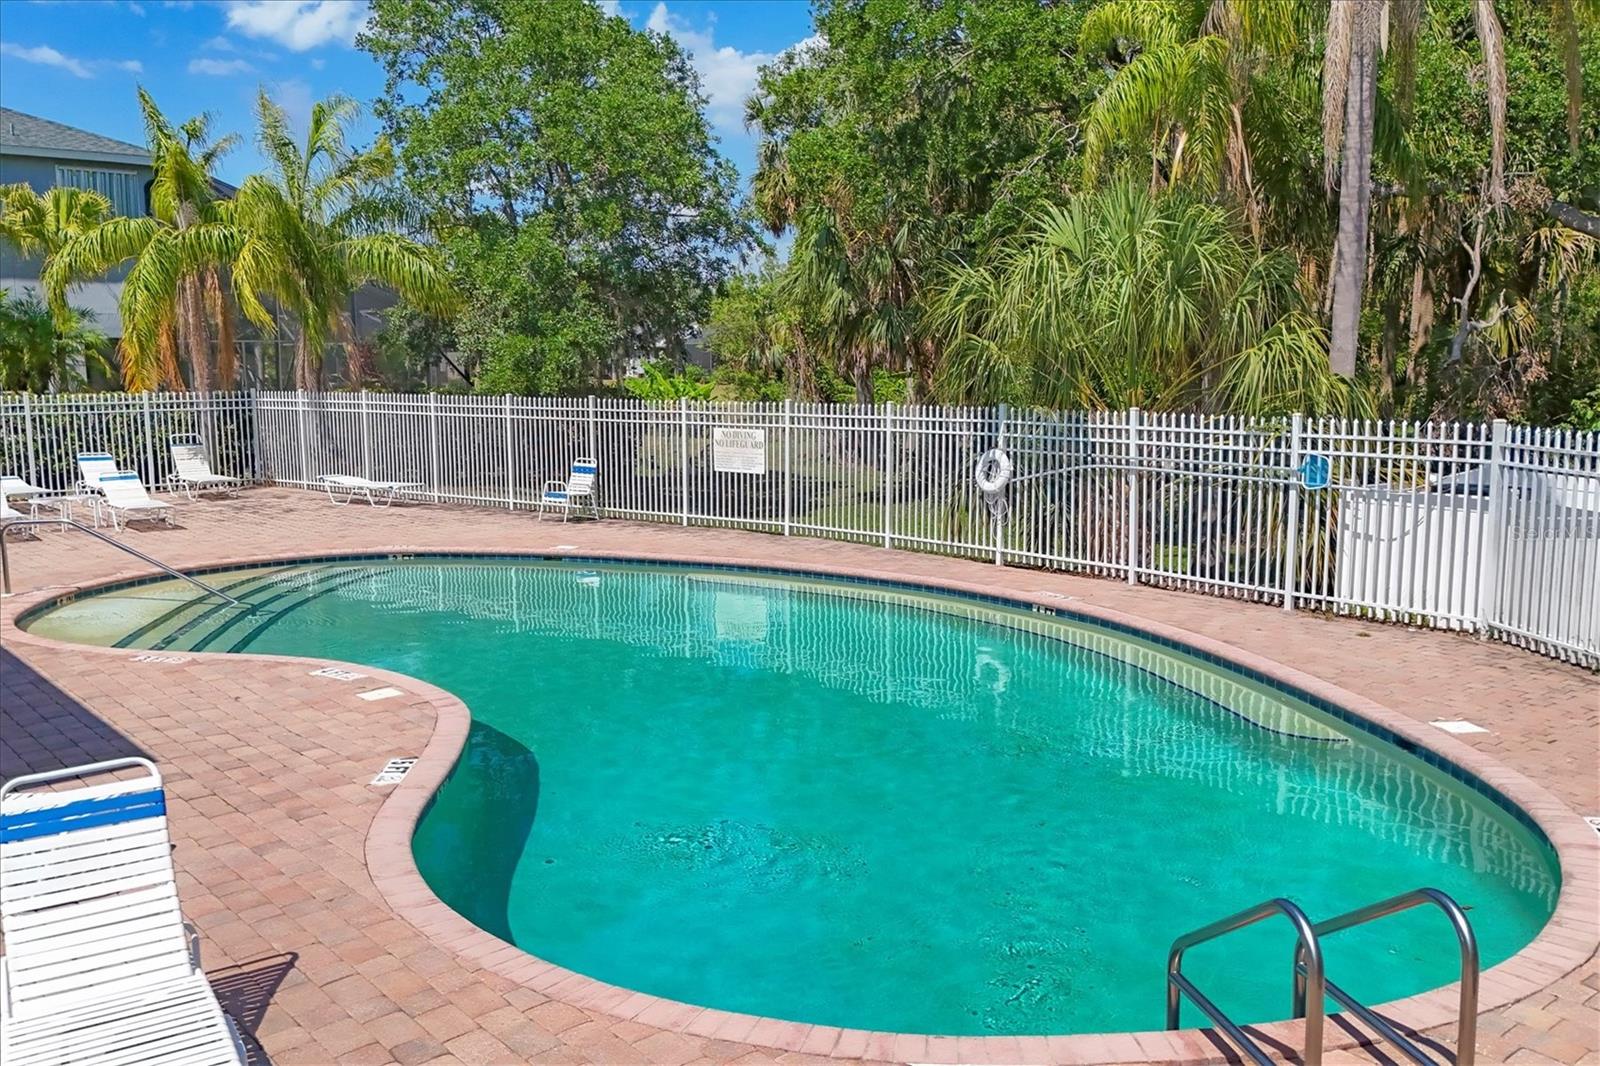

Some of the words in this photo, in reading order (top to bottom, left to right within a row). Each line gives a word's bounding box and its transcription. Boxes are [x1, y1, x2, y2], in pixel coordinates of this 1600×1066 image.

[721, 431, 731, 439] NO
[733, 431, 757, 440] DIVING
[715, 439, 724, 447] NO
[725, 440, 764, 449] LIFEGUARD
